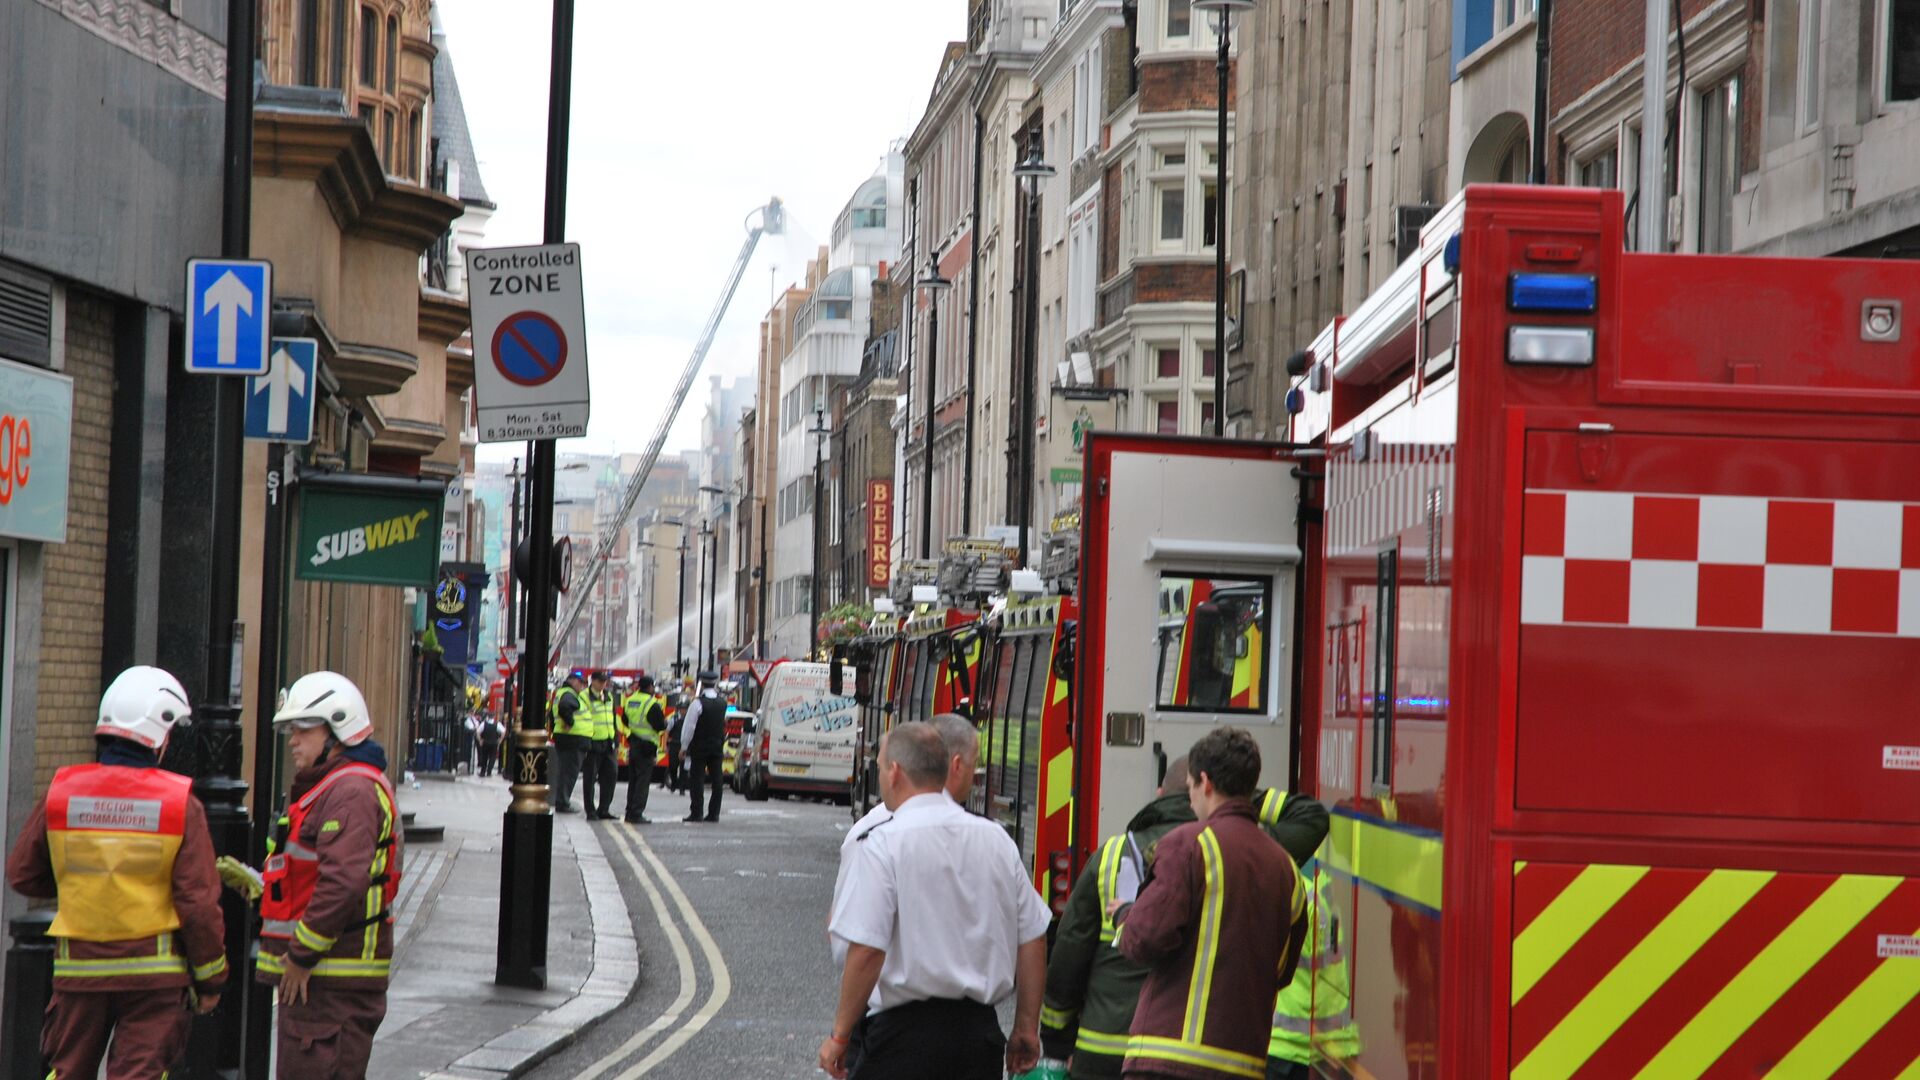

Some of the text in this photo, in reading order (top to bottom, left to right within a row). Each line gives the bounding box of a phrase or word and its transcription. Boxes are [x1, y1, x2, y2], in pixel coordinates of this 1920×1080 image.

[473, 250, 575, 272] Controlled
[489, 273, 561, 296] ZONE
[506, 412, 531, 425] Mon
[541, 411, 562, 423] Sat
[310, 509, 429, 567] SUBWAY
[873, 483, 888, 582] BEERS
[781, 696, 858, 726] Eskimo
[820, 714, 853, 733] Ice
[93, 800, 134, 812] SECTOR
[79, 812, 146, 826] COMMANDER
